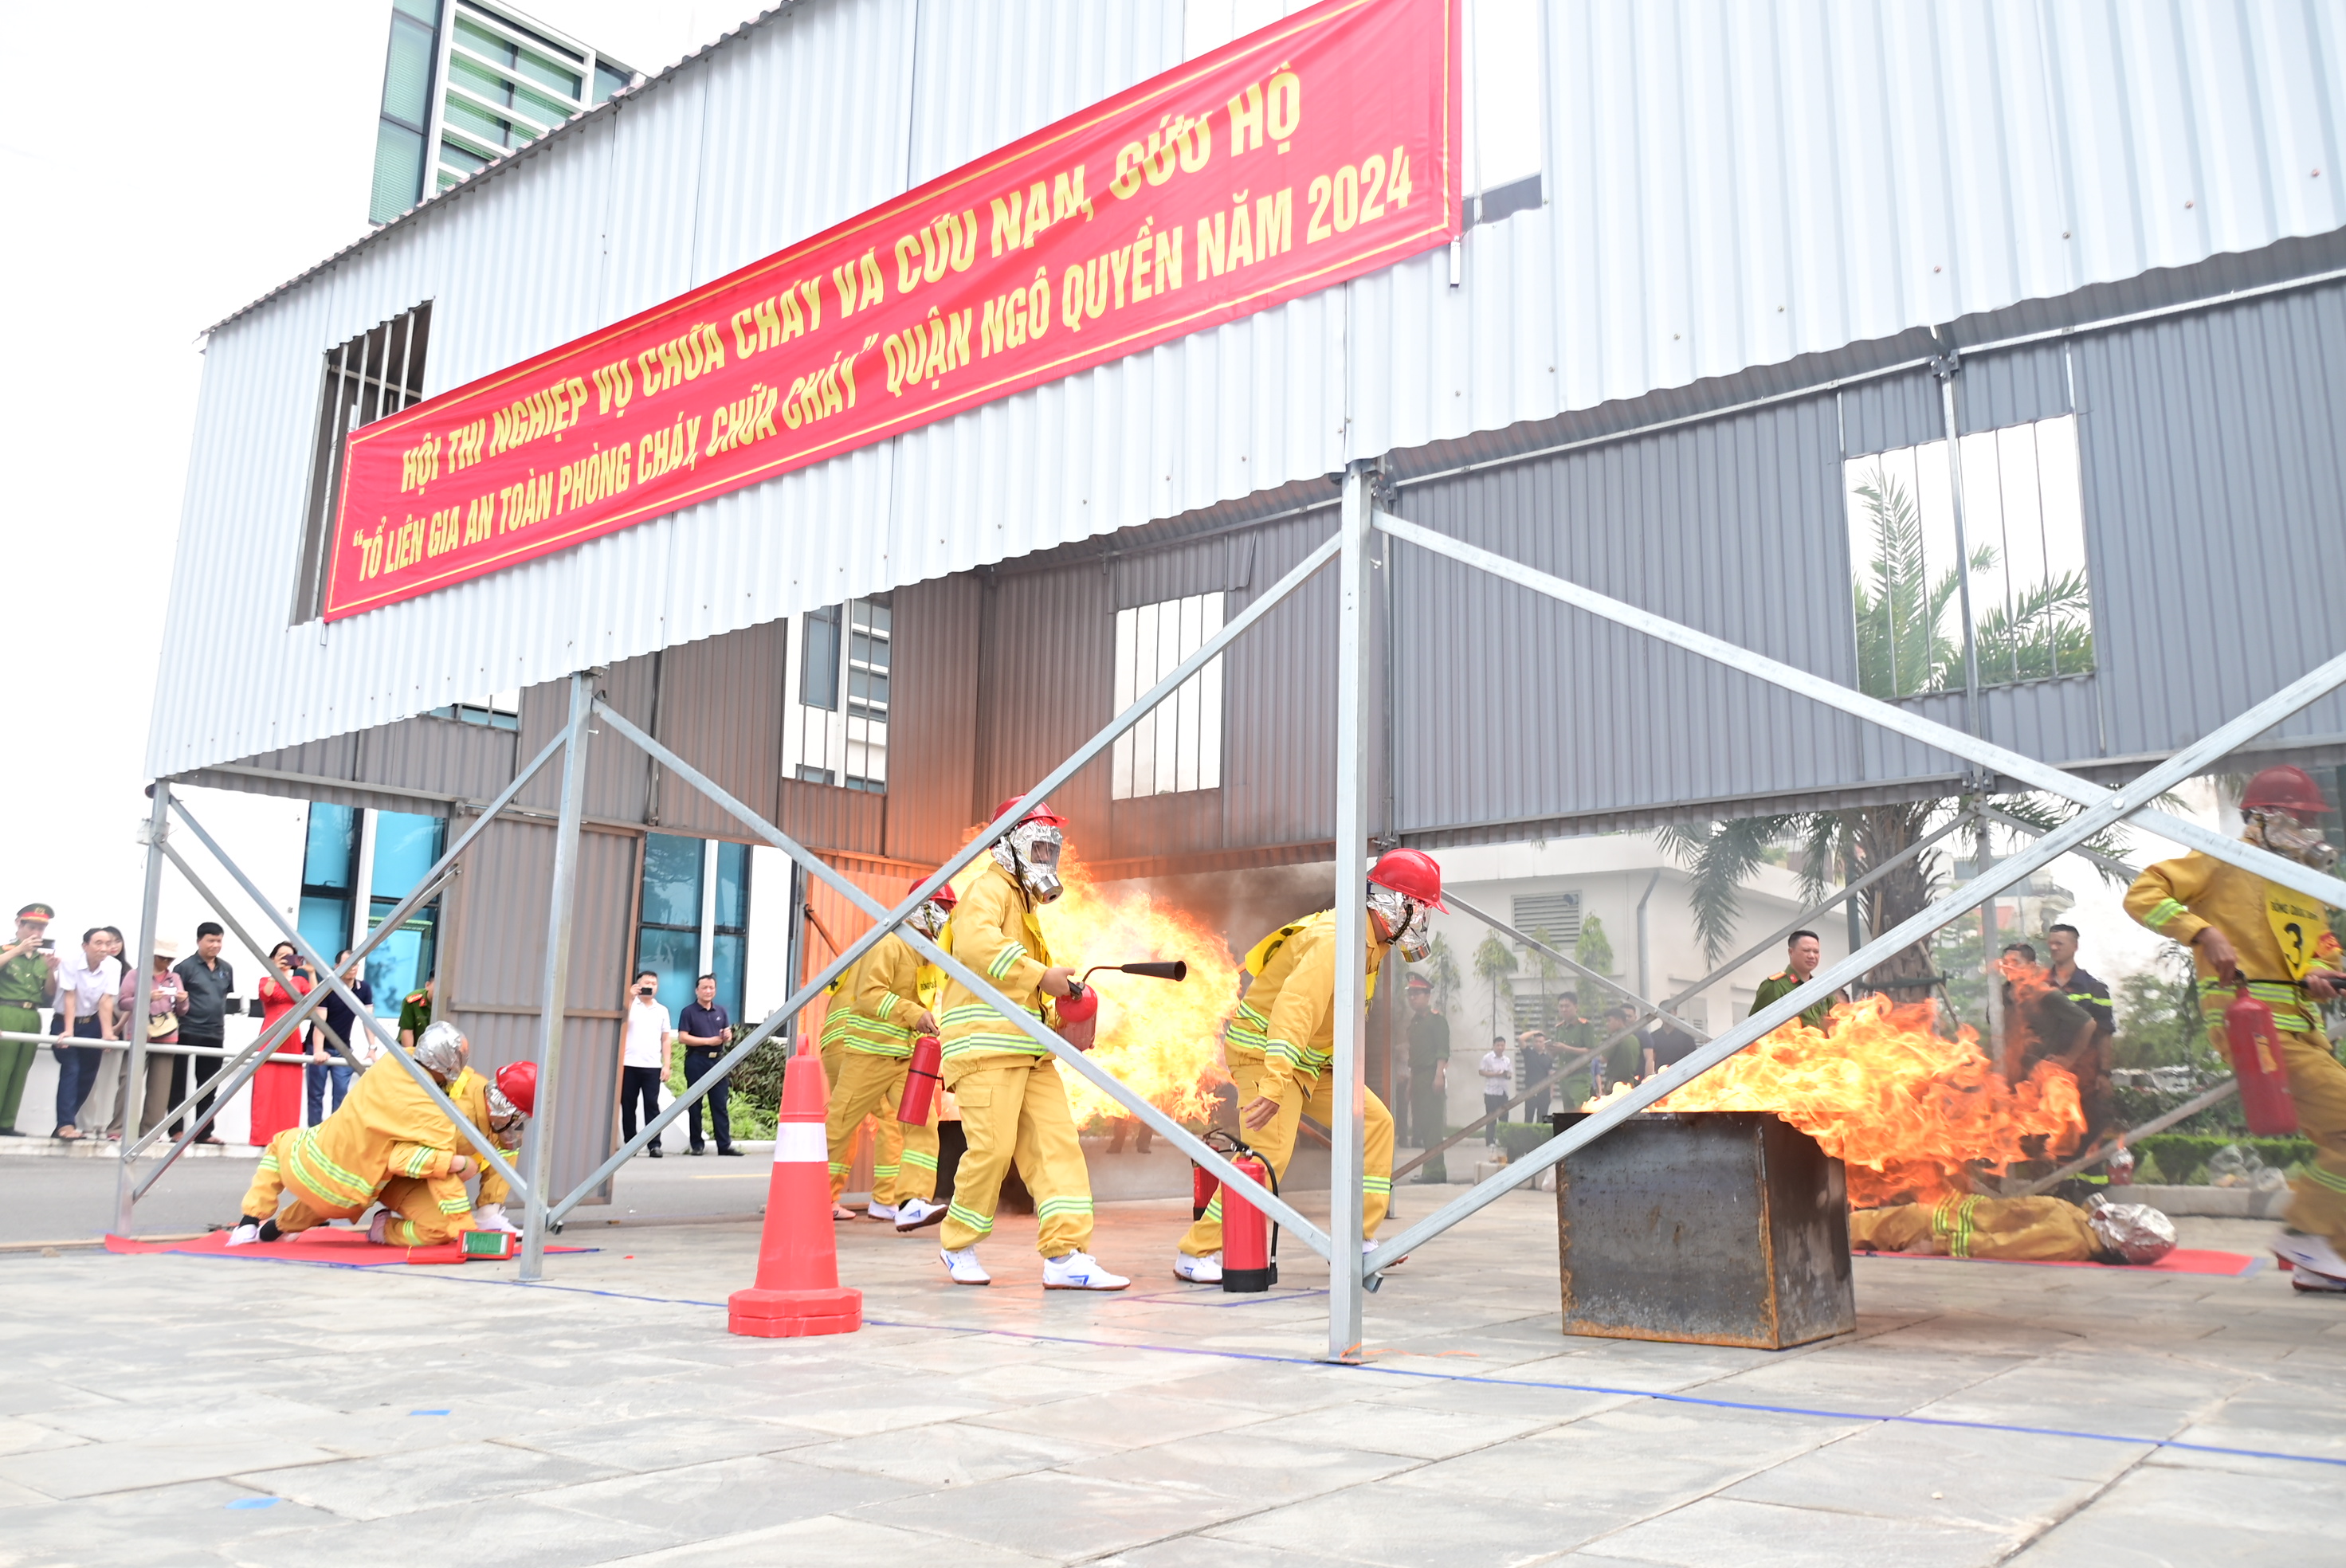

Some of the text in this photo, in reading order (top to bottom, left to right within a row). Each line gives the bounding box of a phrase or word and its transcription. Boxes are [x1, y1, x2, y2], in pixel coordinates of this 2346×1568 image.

[383, 513, 426, 574] LIÊN
[427, 506, 461, 559] GIA
[463, 492, 495, 547] AN
[500, 468, 554, 535] TOÀN
[556, 441, 632, 515] PHÒNG
[638, 411, 702, 484] CHÁY,
[705, 382, 779, 457] CHỮA
[882, 305, 973, 398] QUẬN
[981, 265, 1051, 359] NGÔ
[1062, 216, 1183, 332] QUYỀN
[1198, 188, 1293, 281] NĂM
[1308, 146, 1413, 245] 2024
[401, 432, 441, 496] HỘI
[448, 418, 486, 474] THI
[592, 358, 634, 419] VỤ
[638, 322, 725, 397] CHỮA
[731, 275, 822, 360] CHÁY
[895, 209, 979, 294] CỨU
[991, 165, 1094, 257] NẠN,
[1109, 111, 1213, 200] CỨU
[1227, 61, 1301, 157] HỘ
[2284, 922, 2303, 970] 3
